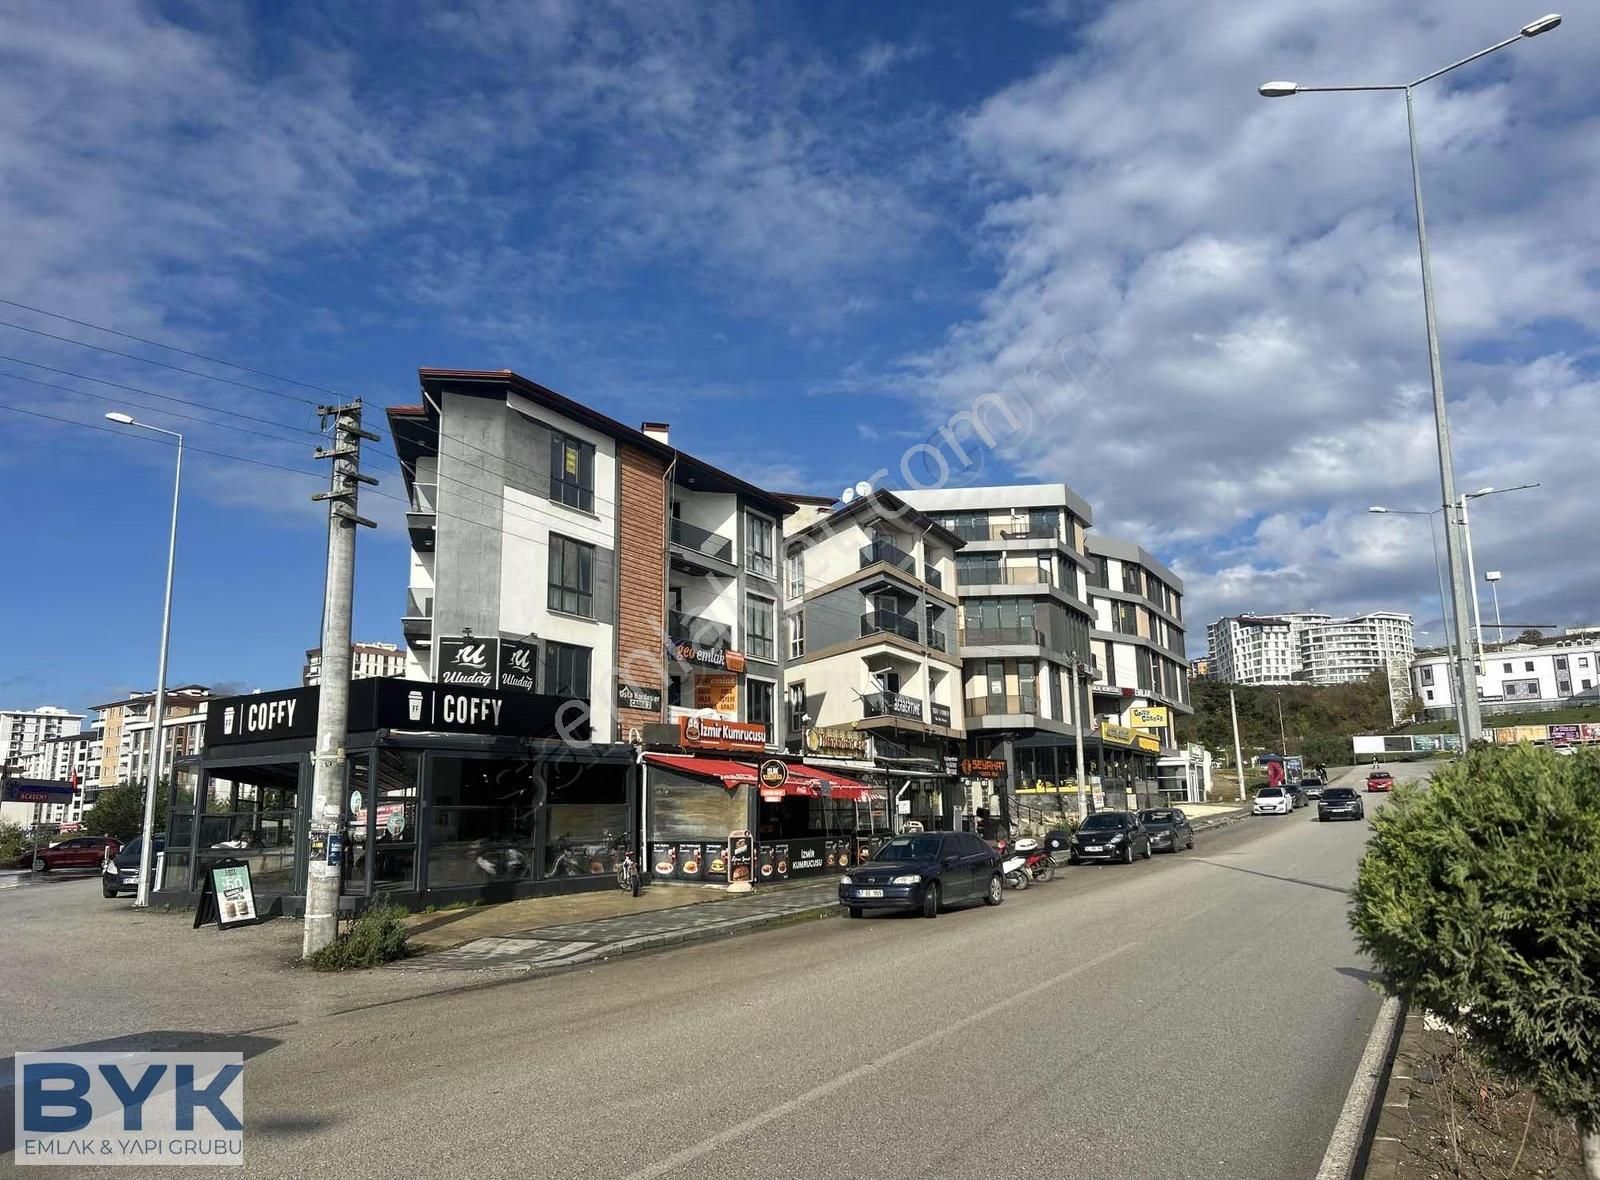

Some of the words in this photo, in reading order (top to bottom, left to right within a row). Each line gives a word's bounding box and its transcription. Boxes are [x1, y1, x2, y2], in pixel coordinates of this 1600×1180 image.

[696, 647, 725, 665] emlak
[442, 671, 492, 686] Uludağ
[502, 673, 533, 691] Uludağ
[248, 699, 297, 731] COFFY
[443, 694, 503, 726] COFFY
[700, 718, 722, 738] İzmir
[722, 724, 766, 743] Kumrucusu
